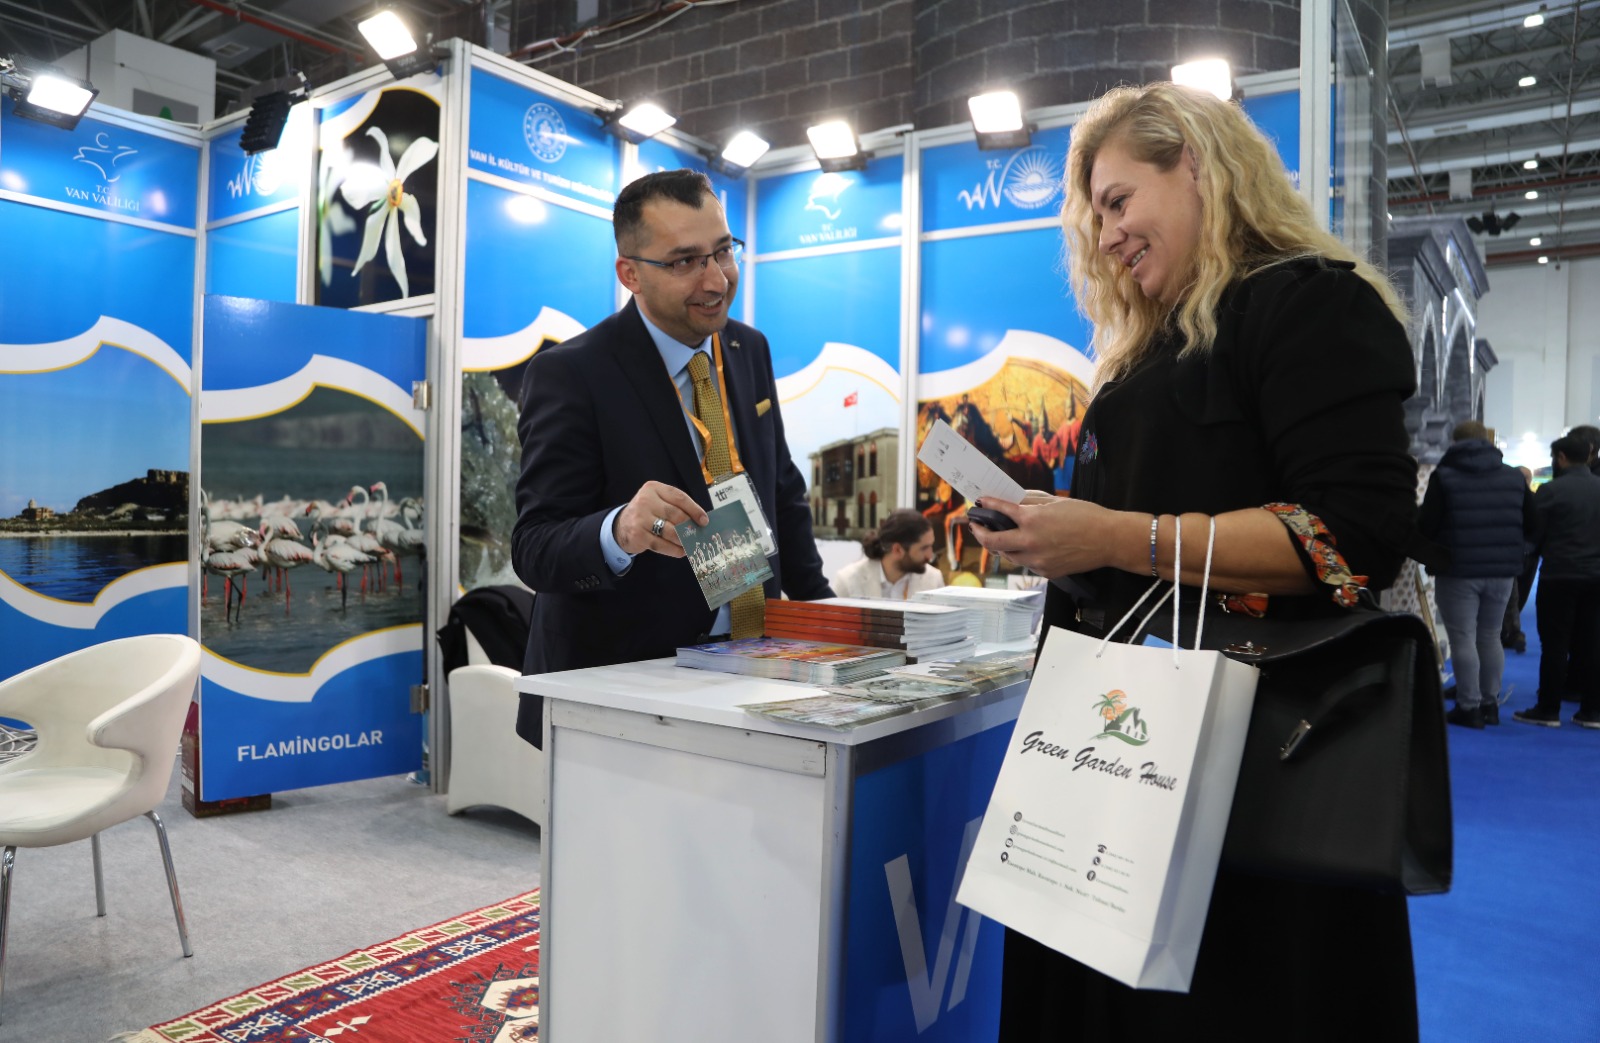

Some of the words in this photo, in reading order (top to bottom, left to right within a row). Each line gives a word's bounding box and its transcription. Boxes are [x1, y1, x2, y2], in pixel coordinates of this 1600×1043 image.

[470, 149, 487, 163] VAN
[65, 187, 90, 201] VAN
[237, 730, 383, 762] FLAMİNGOLAR
[1021, 731, 1070, 759] Green
[1072, 747, 1132, 779] Garden
[1139, 762, 1178, 791] House
